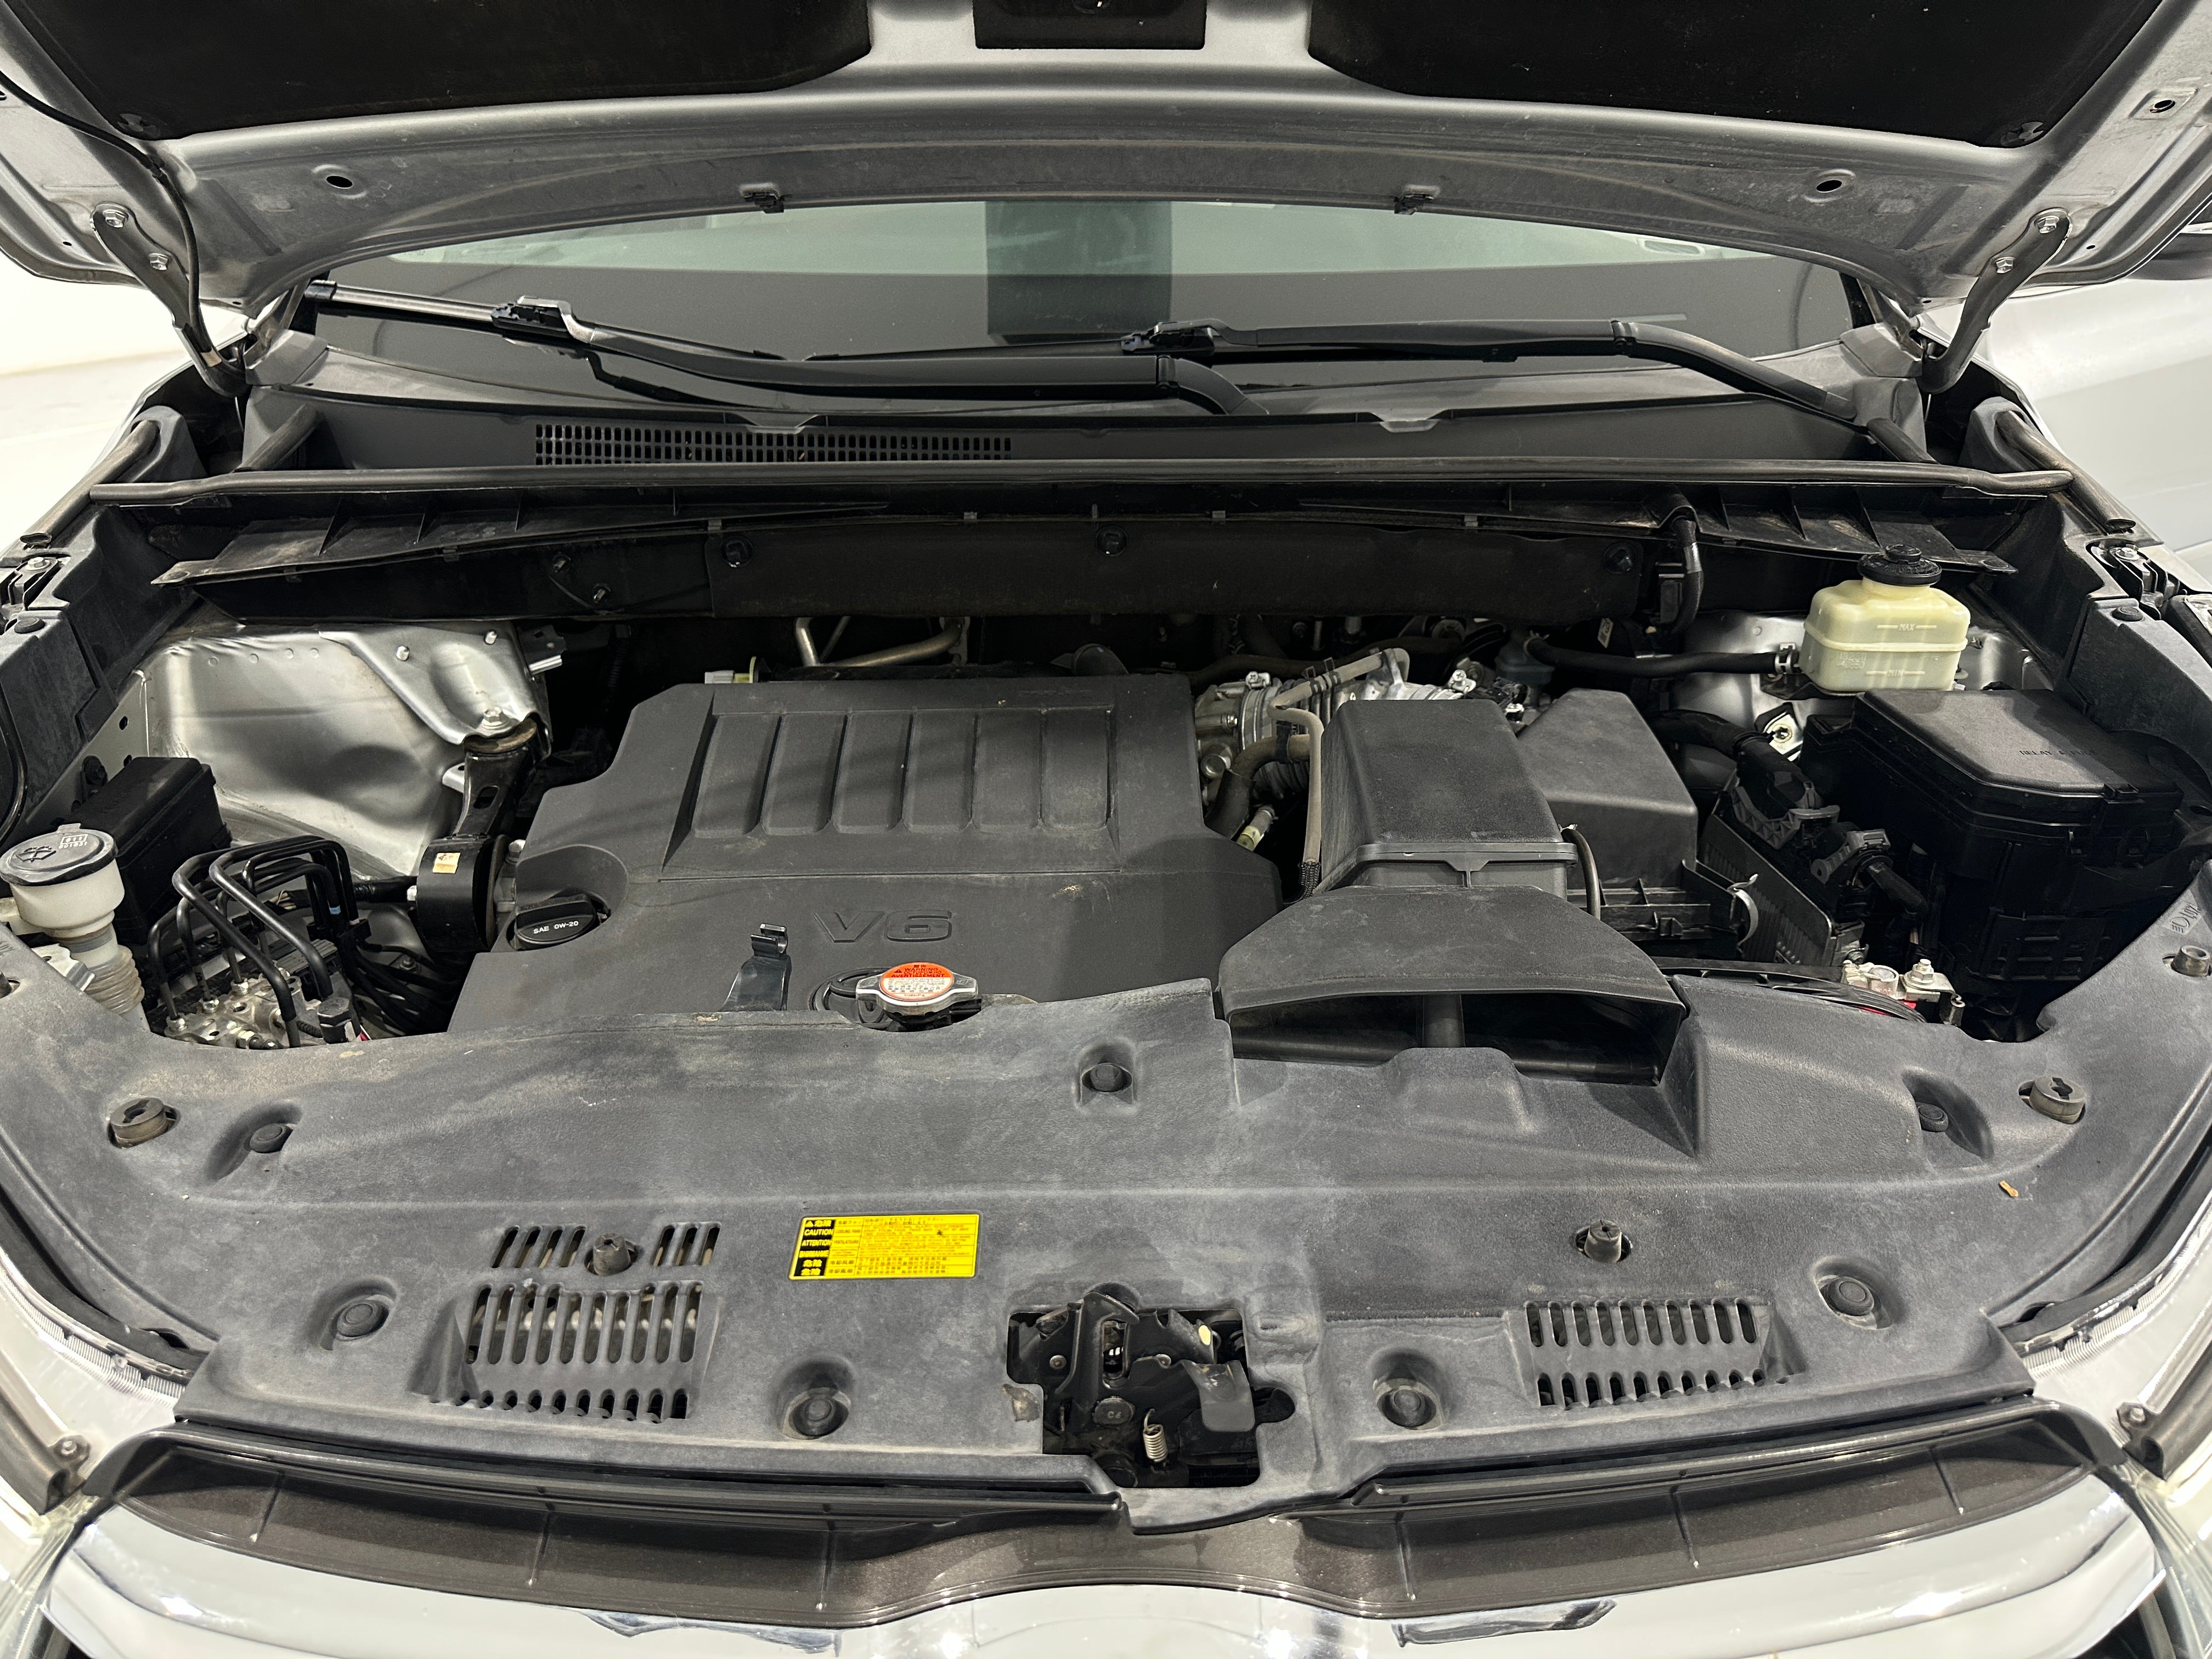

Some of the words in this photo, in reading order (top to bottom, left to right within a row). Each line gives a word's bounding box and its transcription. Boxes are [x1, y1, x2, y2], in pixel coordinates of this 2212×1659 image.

[533, 926, 550, 934] SAE
[554, 921, 579, 930] 0W-20
[812, 910, 952, 943] V6
[801, 1239, 833, 1247] ATTENTION
